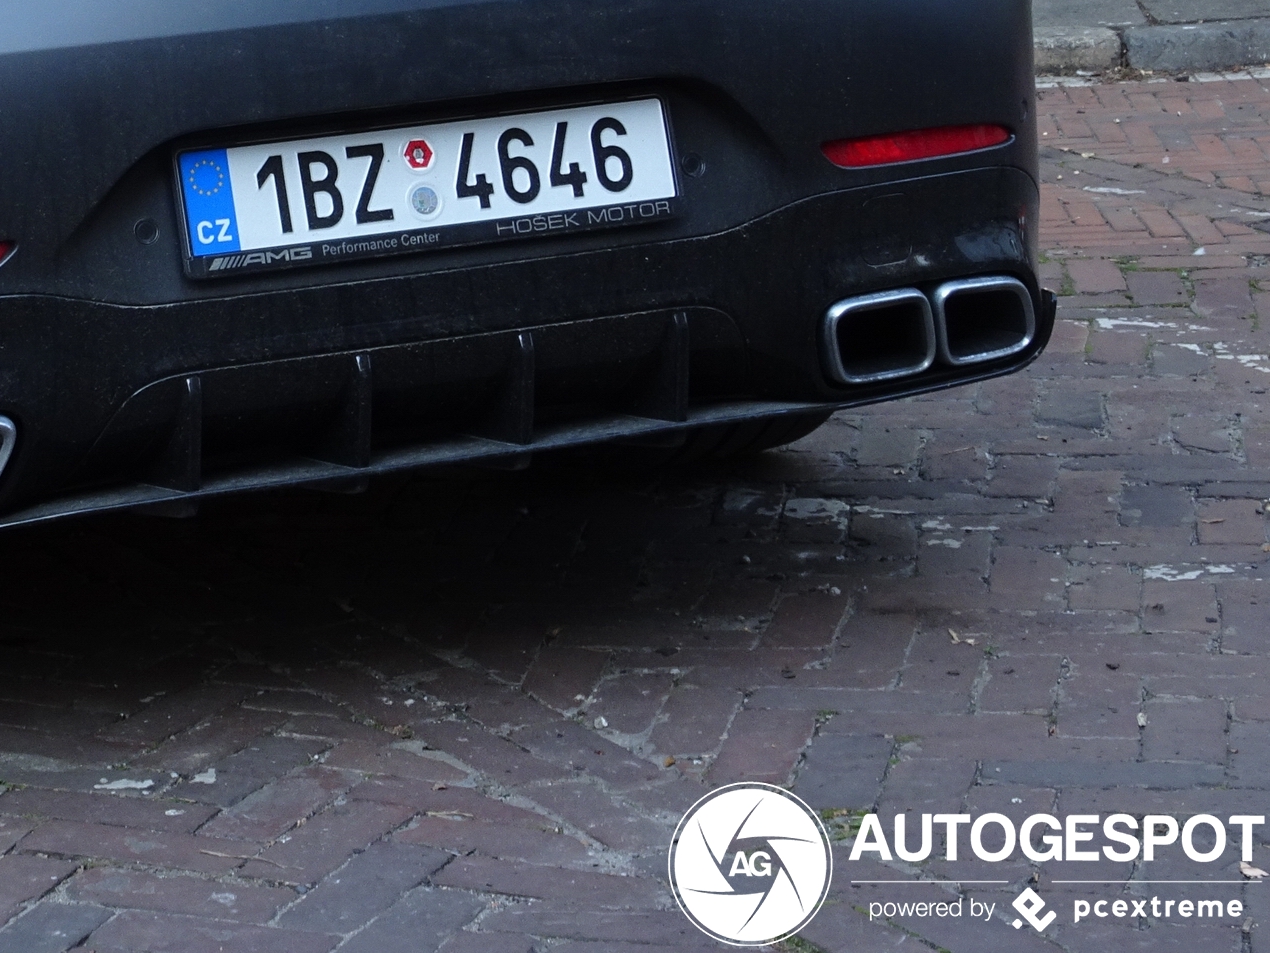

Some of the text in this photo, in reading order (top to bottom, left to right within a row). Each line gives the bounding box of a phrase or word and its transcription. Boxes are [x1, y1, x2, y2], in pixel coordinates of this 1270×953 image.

[256, 116, 634, 235] 1BZ 4646
[196, 218, 233, 245] CZ
[496, 200, 671, 236] HOŠEK MOTOR
[242, 230, 441, 267] AMG Performance Center
